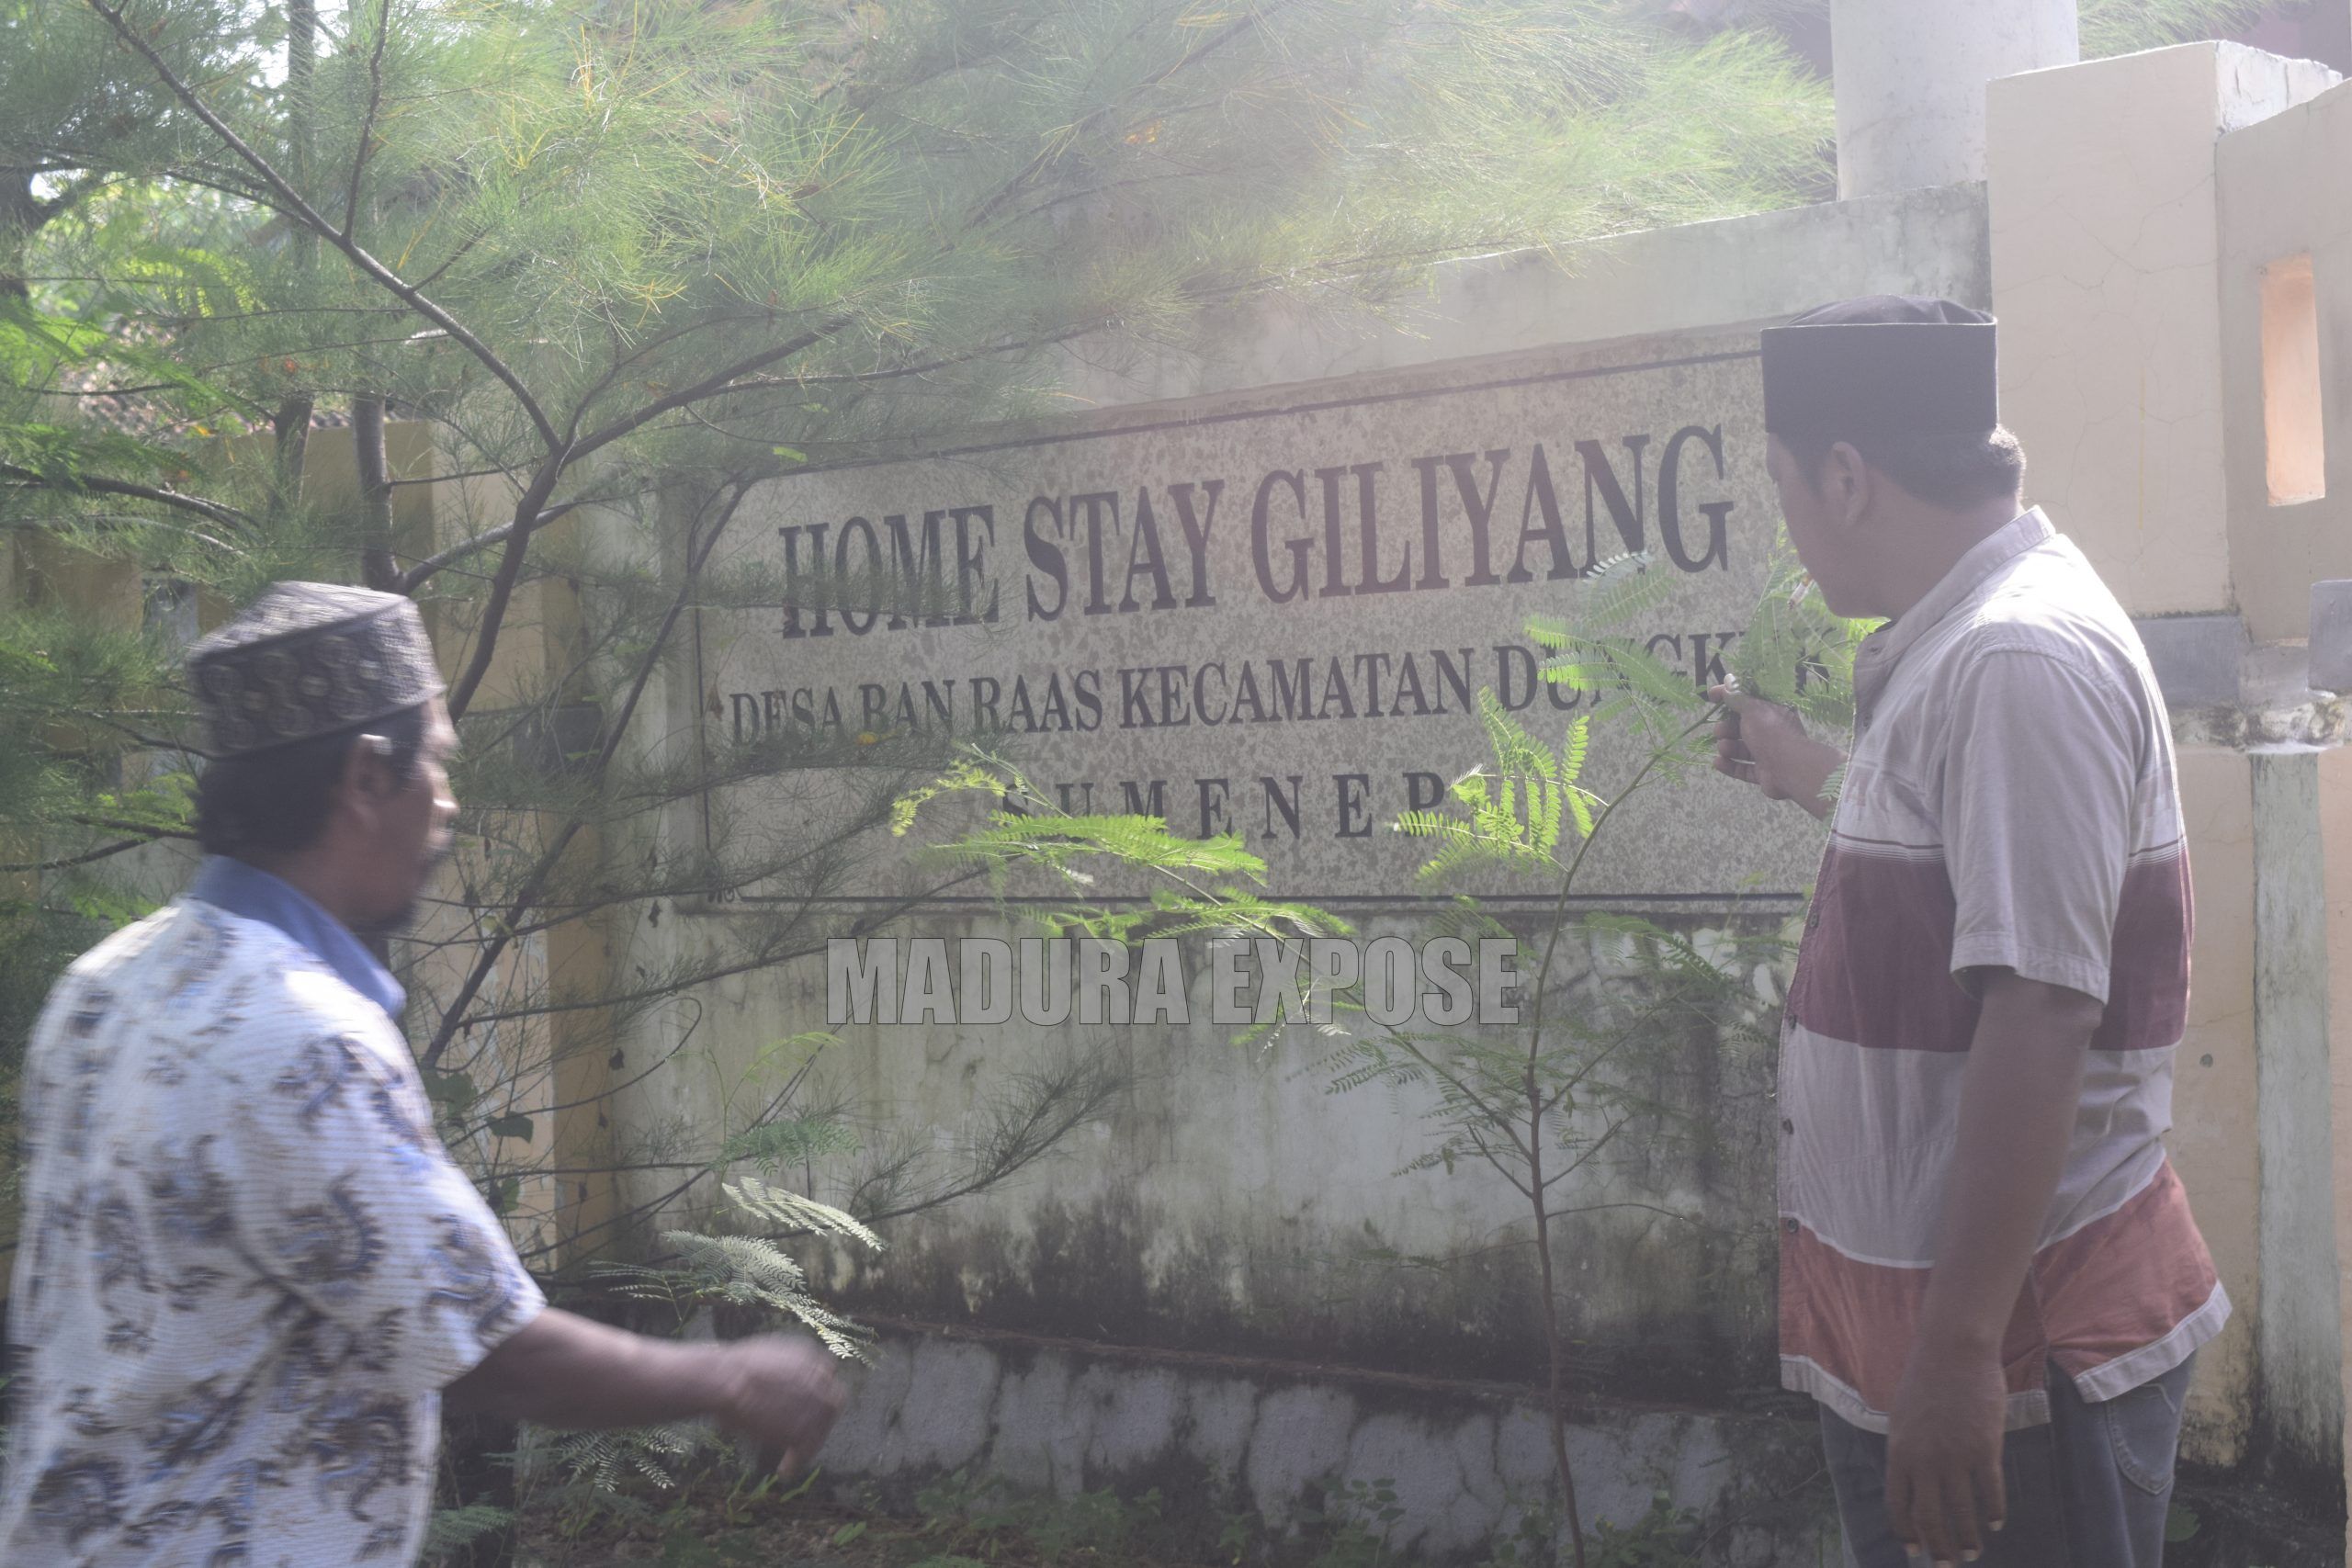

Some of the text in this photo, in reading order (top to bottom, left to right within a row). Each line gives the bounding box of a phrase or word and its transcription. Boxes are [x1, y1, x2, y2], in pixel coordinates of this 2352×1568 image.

[778, 423, 1735, 639] HOME STAY GILIYANG
[729, 685, 842, 748] DESA
[1117, 647, 1476, 729] KECAMATAN
